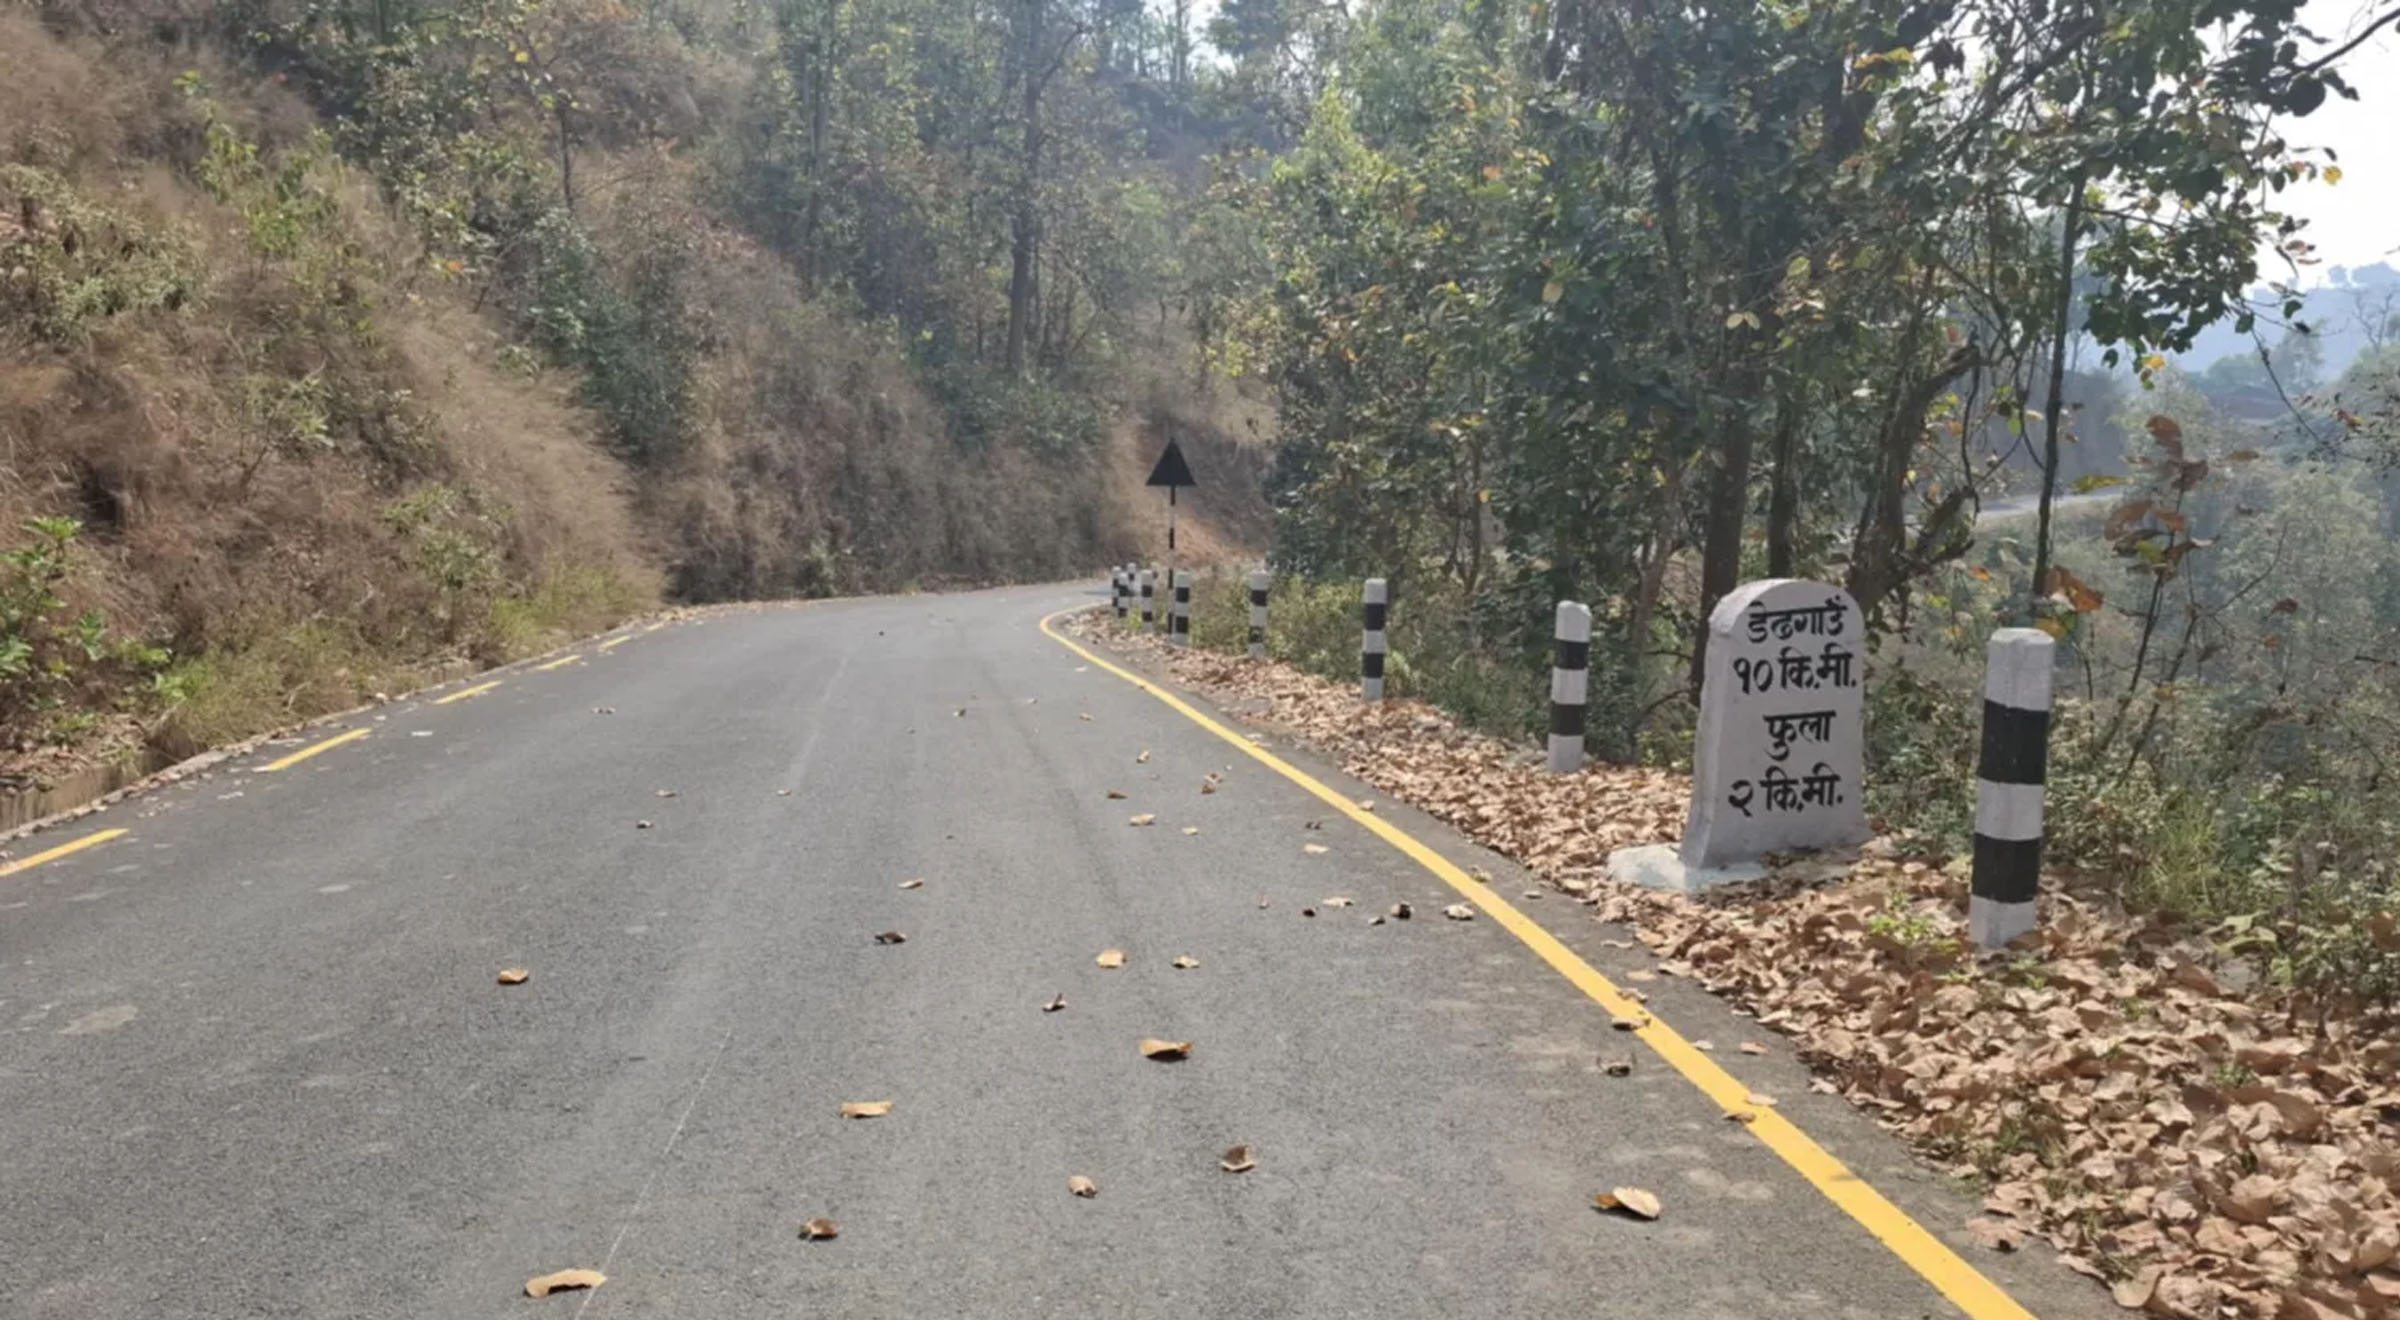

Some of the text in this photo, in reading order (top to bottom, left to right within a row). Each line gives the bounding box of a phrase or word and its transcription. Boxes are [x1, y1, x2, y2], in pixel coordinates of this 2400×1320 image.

[1732, 641, 1858, 695] १० कि.मी.
[1762, 708, 1837, 762] फुला
[1727, 761, 1844, 818] २ कि.मी.
